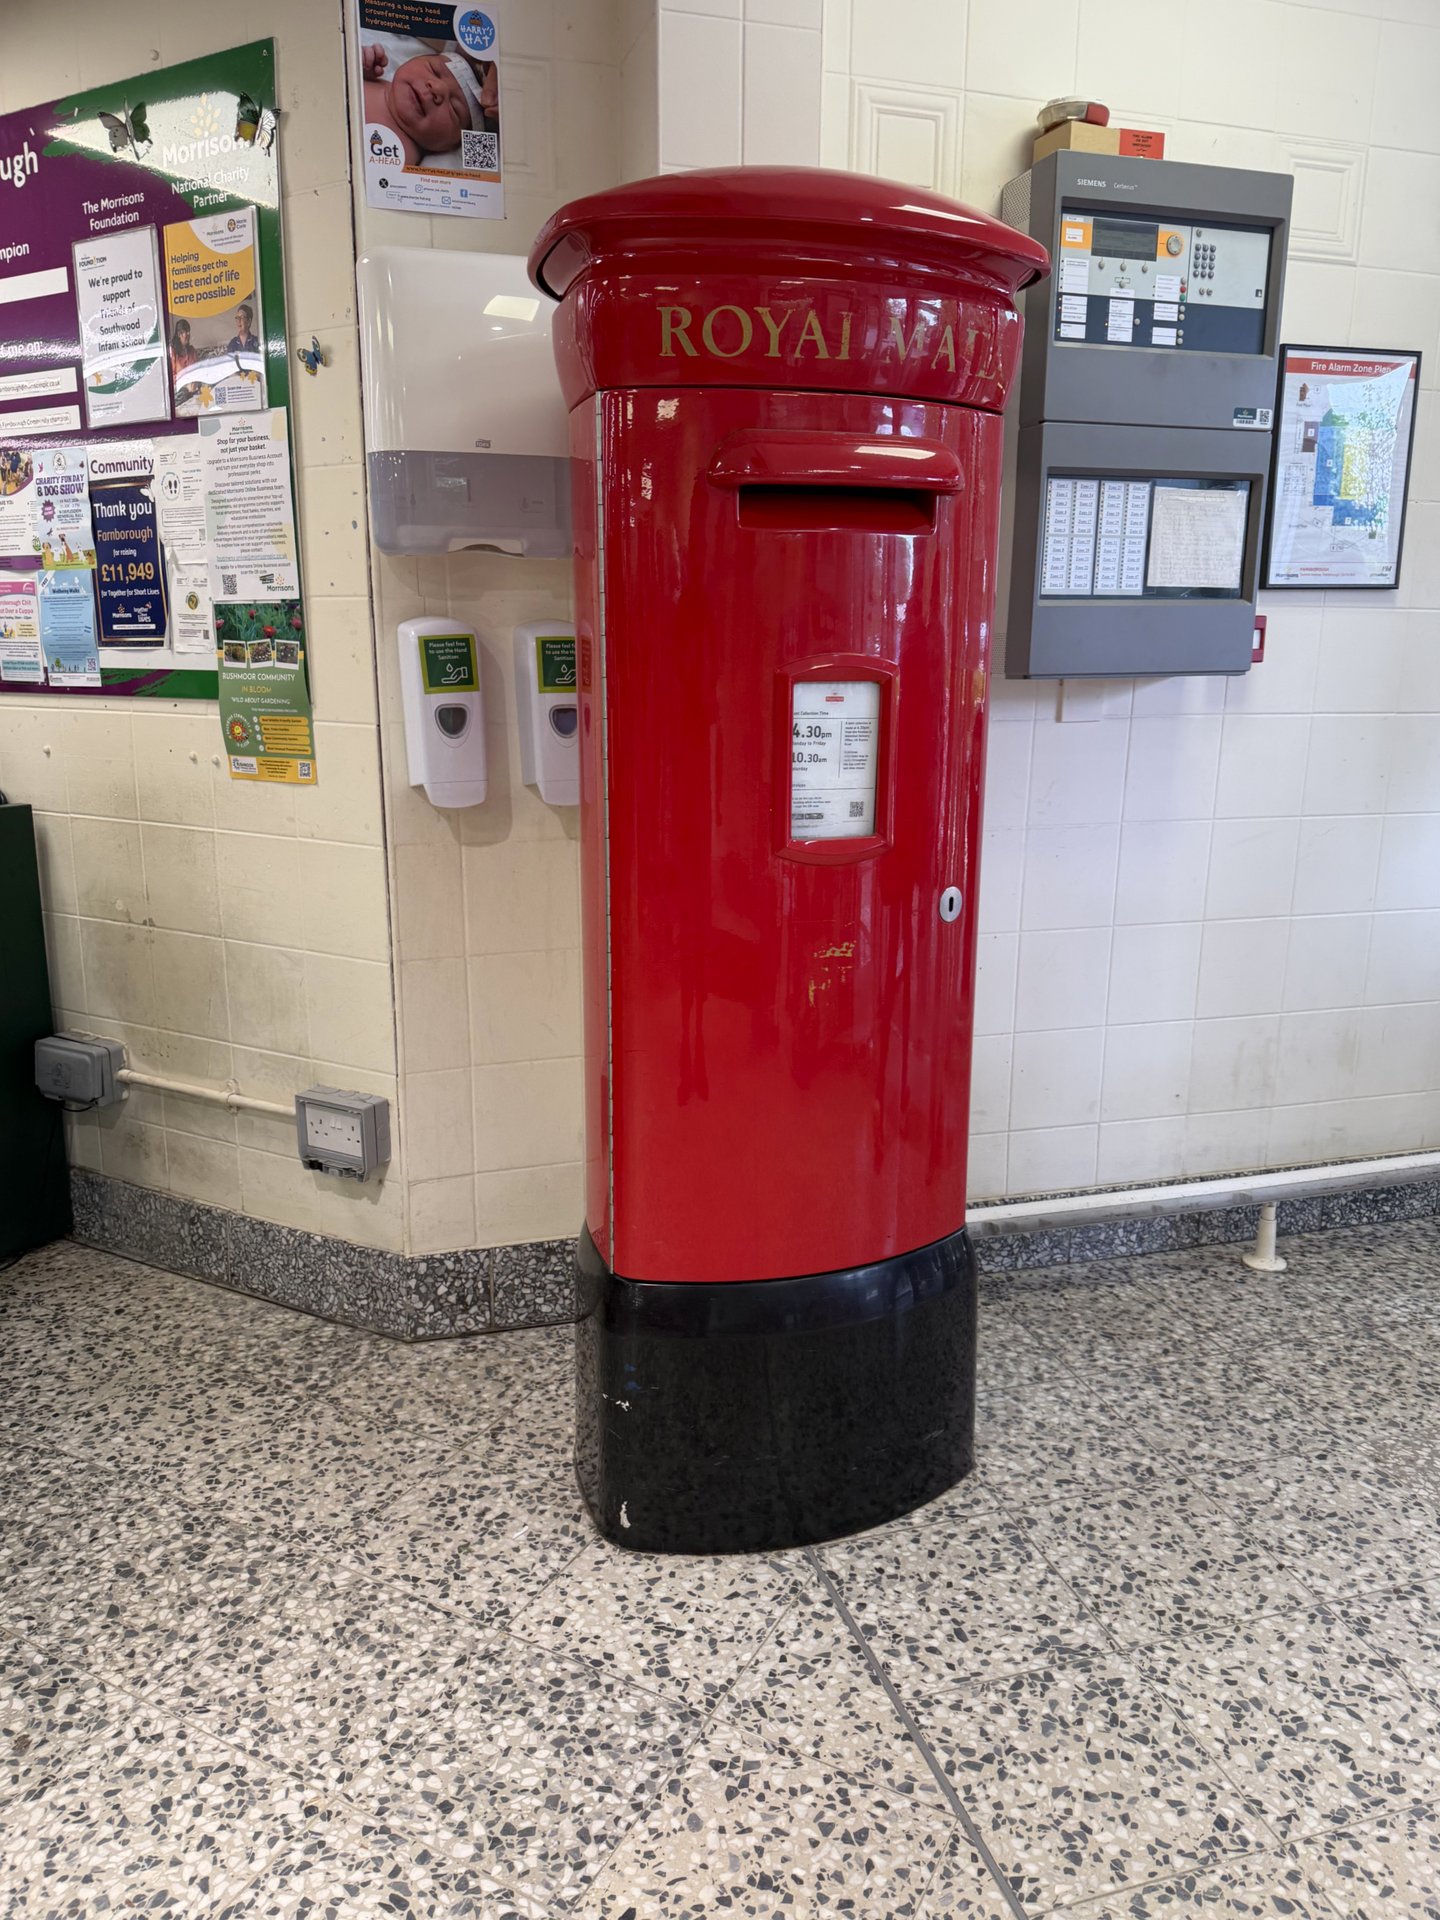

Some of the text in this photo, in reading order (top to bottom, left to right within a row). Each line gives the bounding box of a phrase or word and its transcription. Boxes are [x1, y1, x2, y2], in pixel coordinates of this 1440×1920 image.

[365, 8, 409, 20] circumference
[424, 16, 449, 25] discover
[425, 7, 440, 15] head
[460, 25, 494, 36] HARRY'S
[465, 33, 490, 47] HAT
[370, 143, 399, 158] Get
[369, 157, 401, 166] A-HEAD
[171, 166, 249, 195] National Charity
[1077, 178, 1106, 188] SIEMENS
[82, 192, 145, 215] The Morrisons
[193, 192, 228, 208] Partner
[90, 211, 139, 231] Foundation
[170, 251, 199, 264] Helping
[171, 258, 228, 276] families get the
[88, 269, 142, 288] We're proud to
[172, 269, 240, 291] best end of life
[102, 289, 130, 304] support
[173, 285, 236, 305] care possible
[99, 318, 141, 336] Southwood
[1311, 361, 1327, 371] Fire
[1328, 362, 1352, 372] Alarm
[1353, 364, 1372, 373] Zone
[217, 438, 228, 446] Shop
[236, 437, 247, 445] your
[91, 456, 154, 475] Community
[35, 474, 84, 485] CHARITY FUN DAY
[37, 483, 84, 497] & DOG SHOW
[94, 501, 126, 518] Thank
[128, 503, 152, 521] you
[97, 526, 153, 544] Farnborough
[101, 562, 154, 584] £11,949
[134, 588, 146, 597] Short
[147, 587, 159, 596] Lives
[222, 672, 295, 681] RUSHMOOR COMMUNITY
[793, 723, 832, 739] 4.30pm
